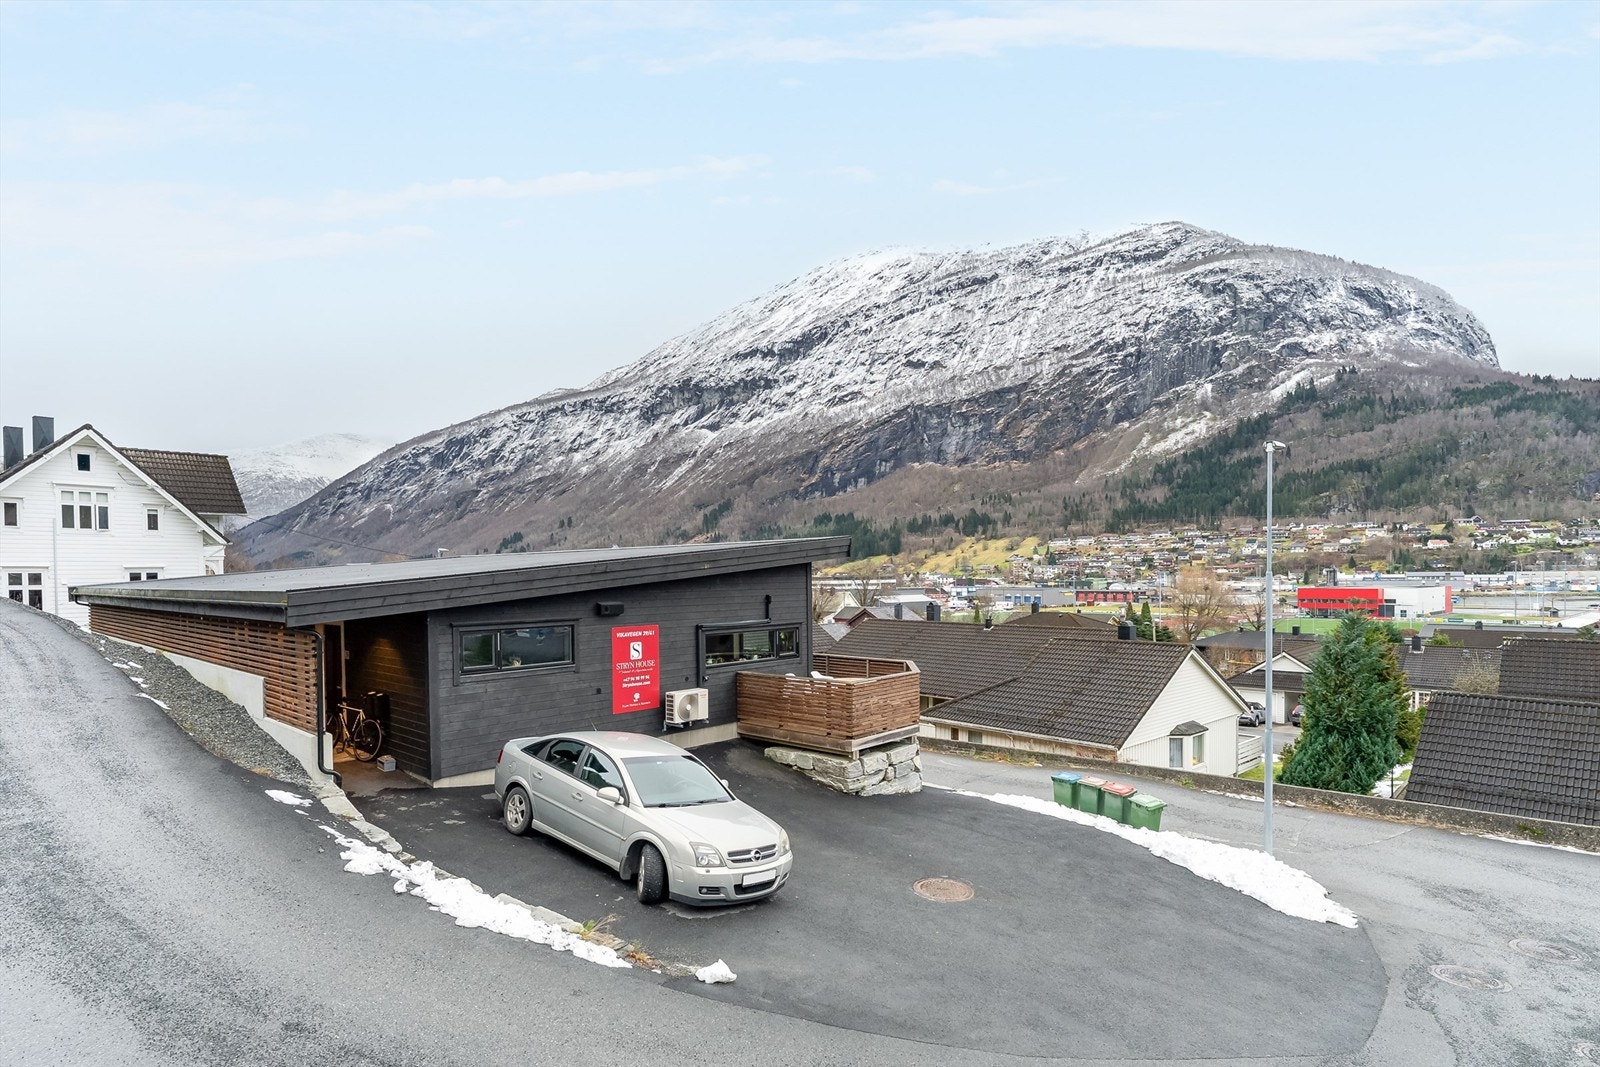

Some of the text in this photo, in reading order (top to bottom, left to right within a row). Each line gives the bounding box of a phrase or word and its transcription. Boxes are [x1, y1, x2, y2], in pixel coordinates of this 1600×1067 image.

[632, 643, 640, 658] S
[616, 660, 656, 670] STRYN HOUSE
